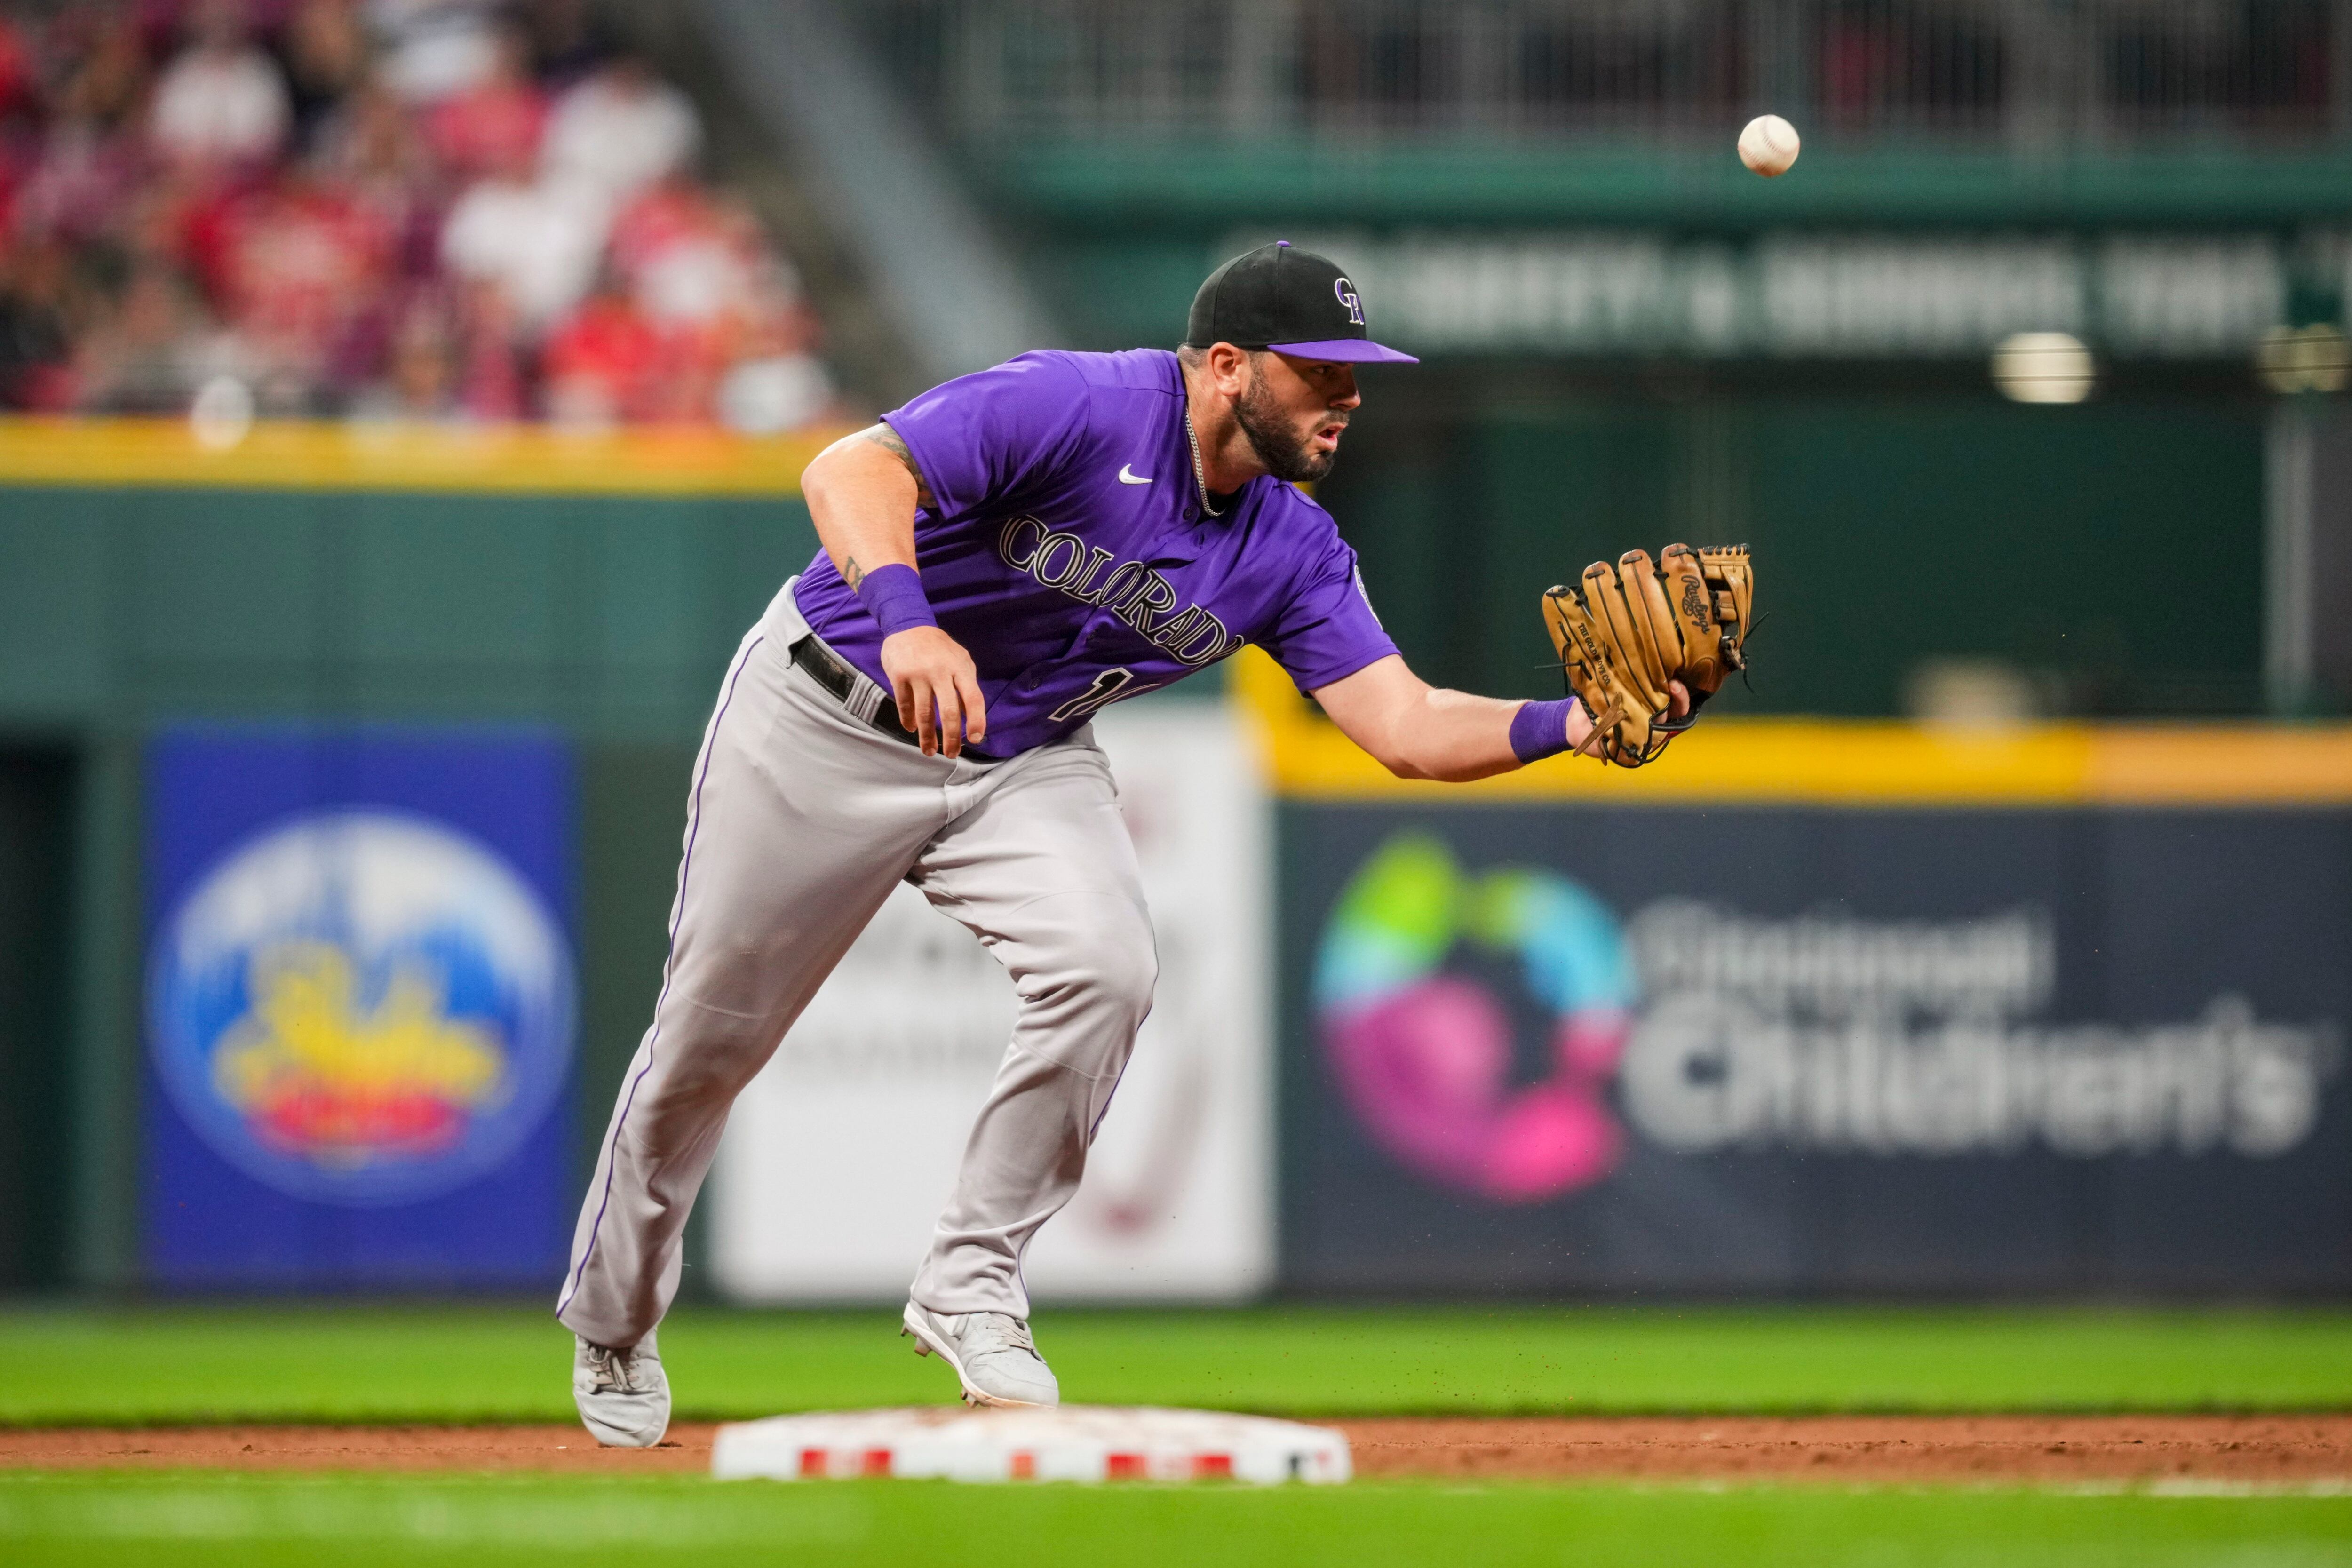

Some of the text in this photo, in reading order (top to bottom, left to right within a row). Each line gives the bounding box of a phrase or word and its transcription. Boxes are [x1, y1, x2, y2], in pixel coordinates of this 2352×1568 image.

[1681, 575, 1710, 635] Rawlings
[1578, 622, 1589, 638] THE
[1585, 637, 1597, 655] GOLD
[1594, 654, 1606, 676] OVE
[1047, 667, 1161, 722] 1
